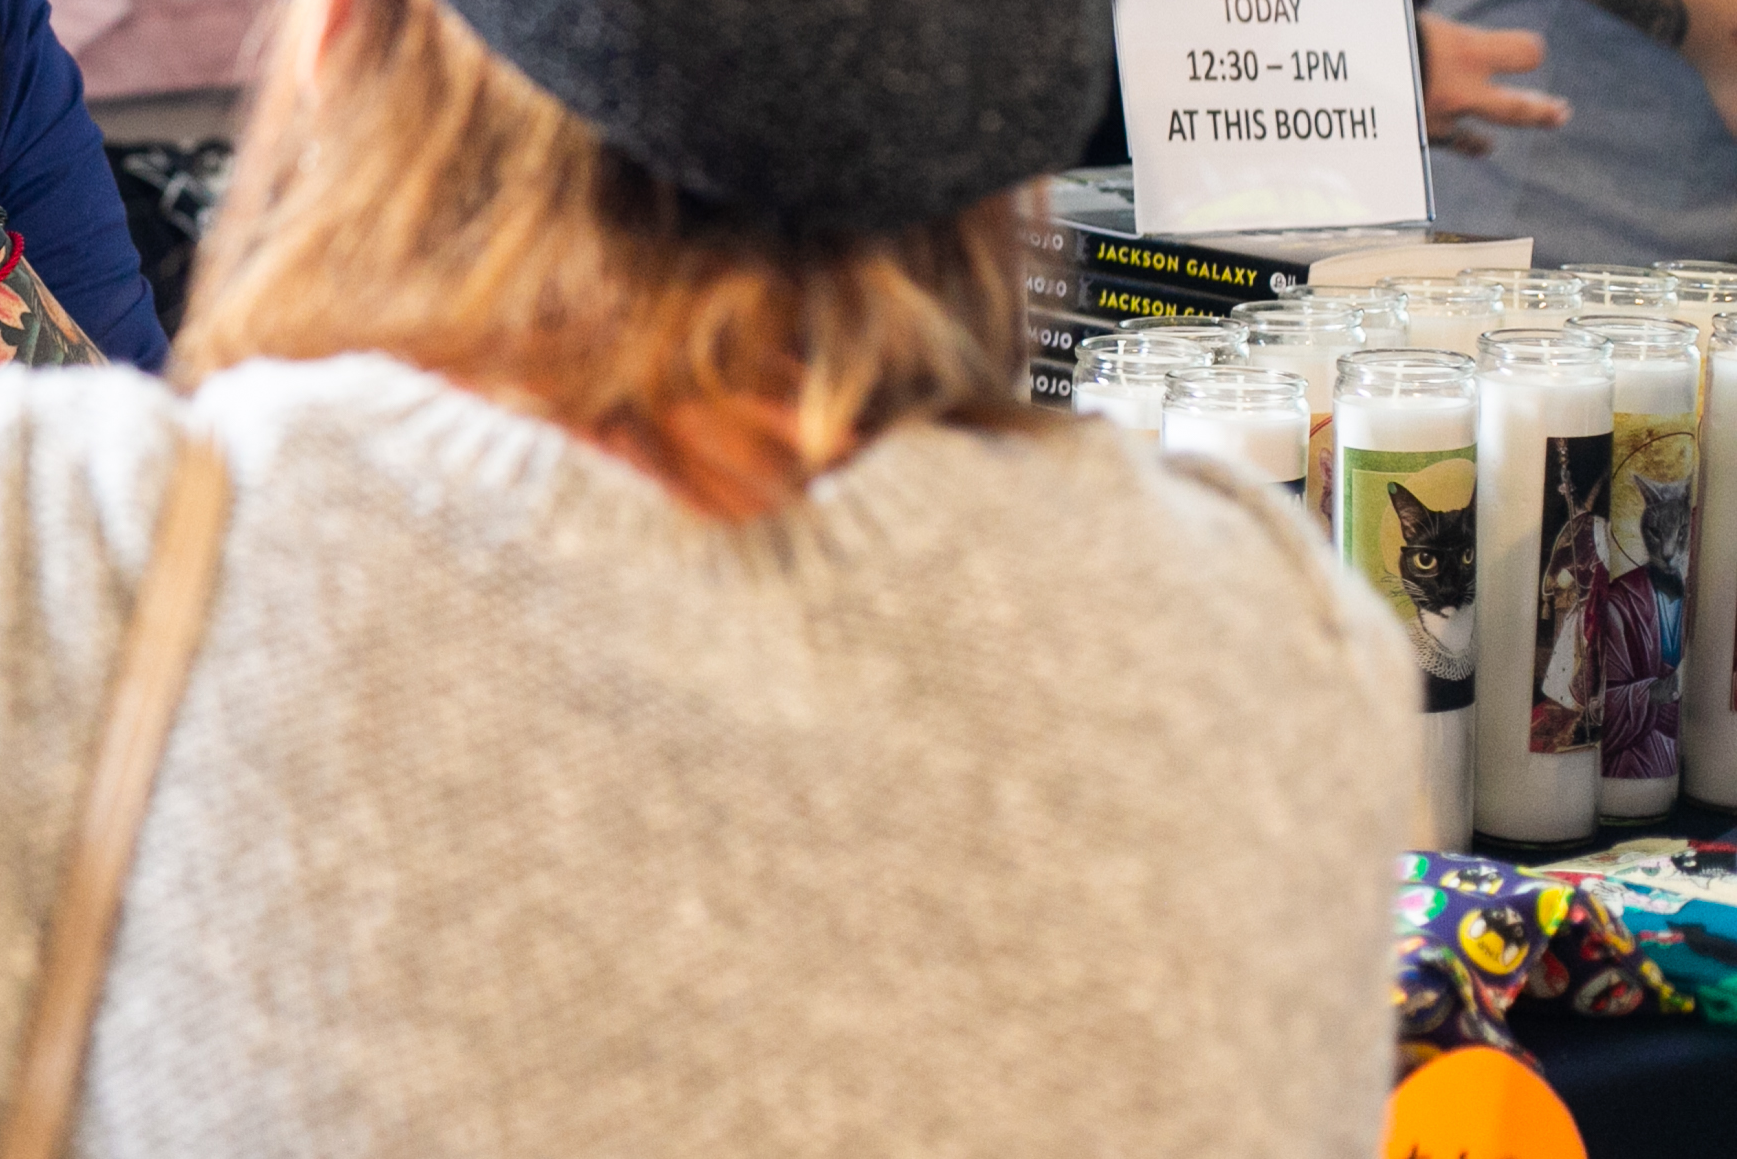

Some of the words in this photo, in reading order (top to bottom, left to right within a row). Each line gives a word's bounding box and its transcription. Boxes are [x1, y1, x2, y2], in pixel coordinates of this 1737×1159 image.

[1187, 49, 1259, 82] 12:30
[1291, 49, 1348, 82] 1PM
[1168, 109, 1199, 141] AT
[1206, 108, 1267, 140] THIS
[1274, 106, 1378, 140] BOOTH!
[1024, 229, 1064, 251] OJO
[1097, 242, 1180, 273] JACKSON
[1186, 259, 1258, 288] GALAXY
[1098, 288, 1178, 317] JACKSON
